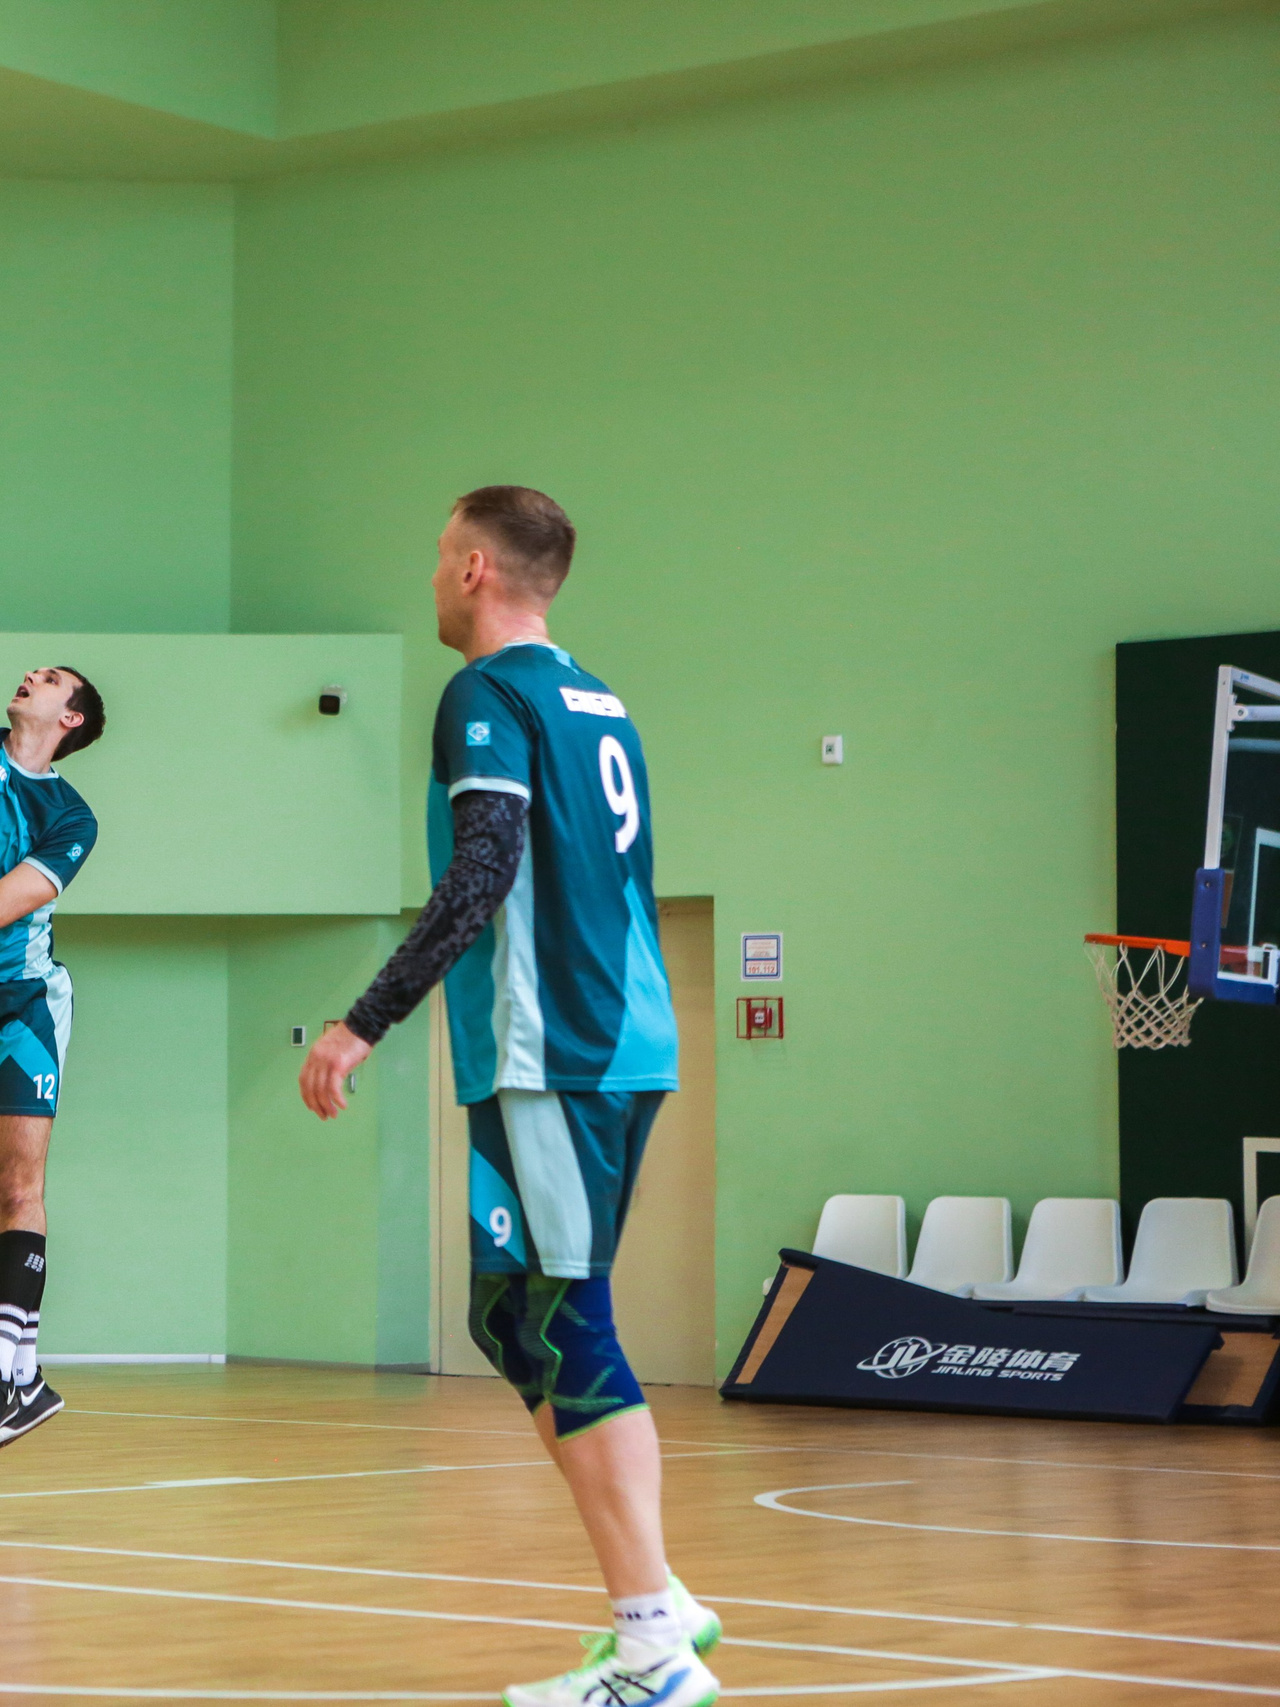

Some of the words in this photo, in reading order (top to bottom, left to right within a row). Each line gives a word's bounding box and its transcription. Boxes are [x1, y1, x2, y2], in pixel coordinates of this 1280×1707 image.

[599, 734, 640, 854] 9
[33, 1073, 56, 1100] 12
[489, 1206, 512, 1247] 9
[936, 1344, 1081, 1372] 金陵体育
[931, 1365, 993, 1377] JINLING
[997, 1369, 1065, 1382] SPORTS
